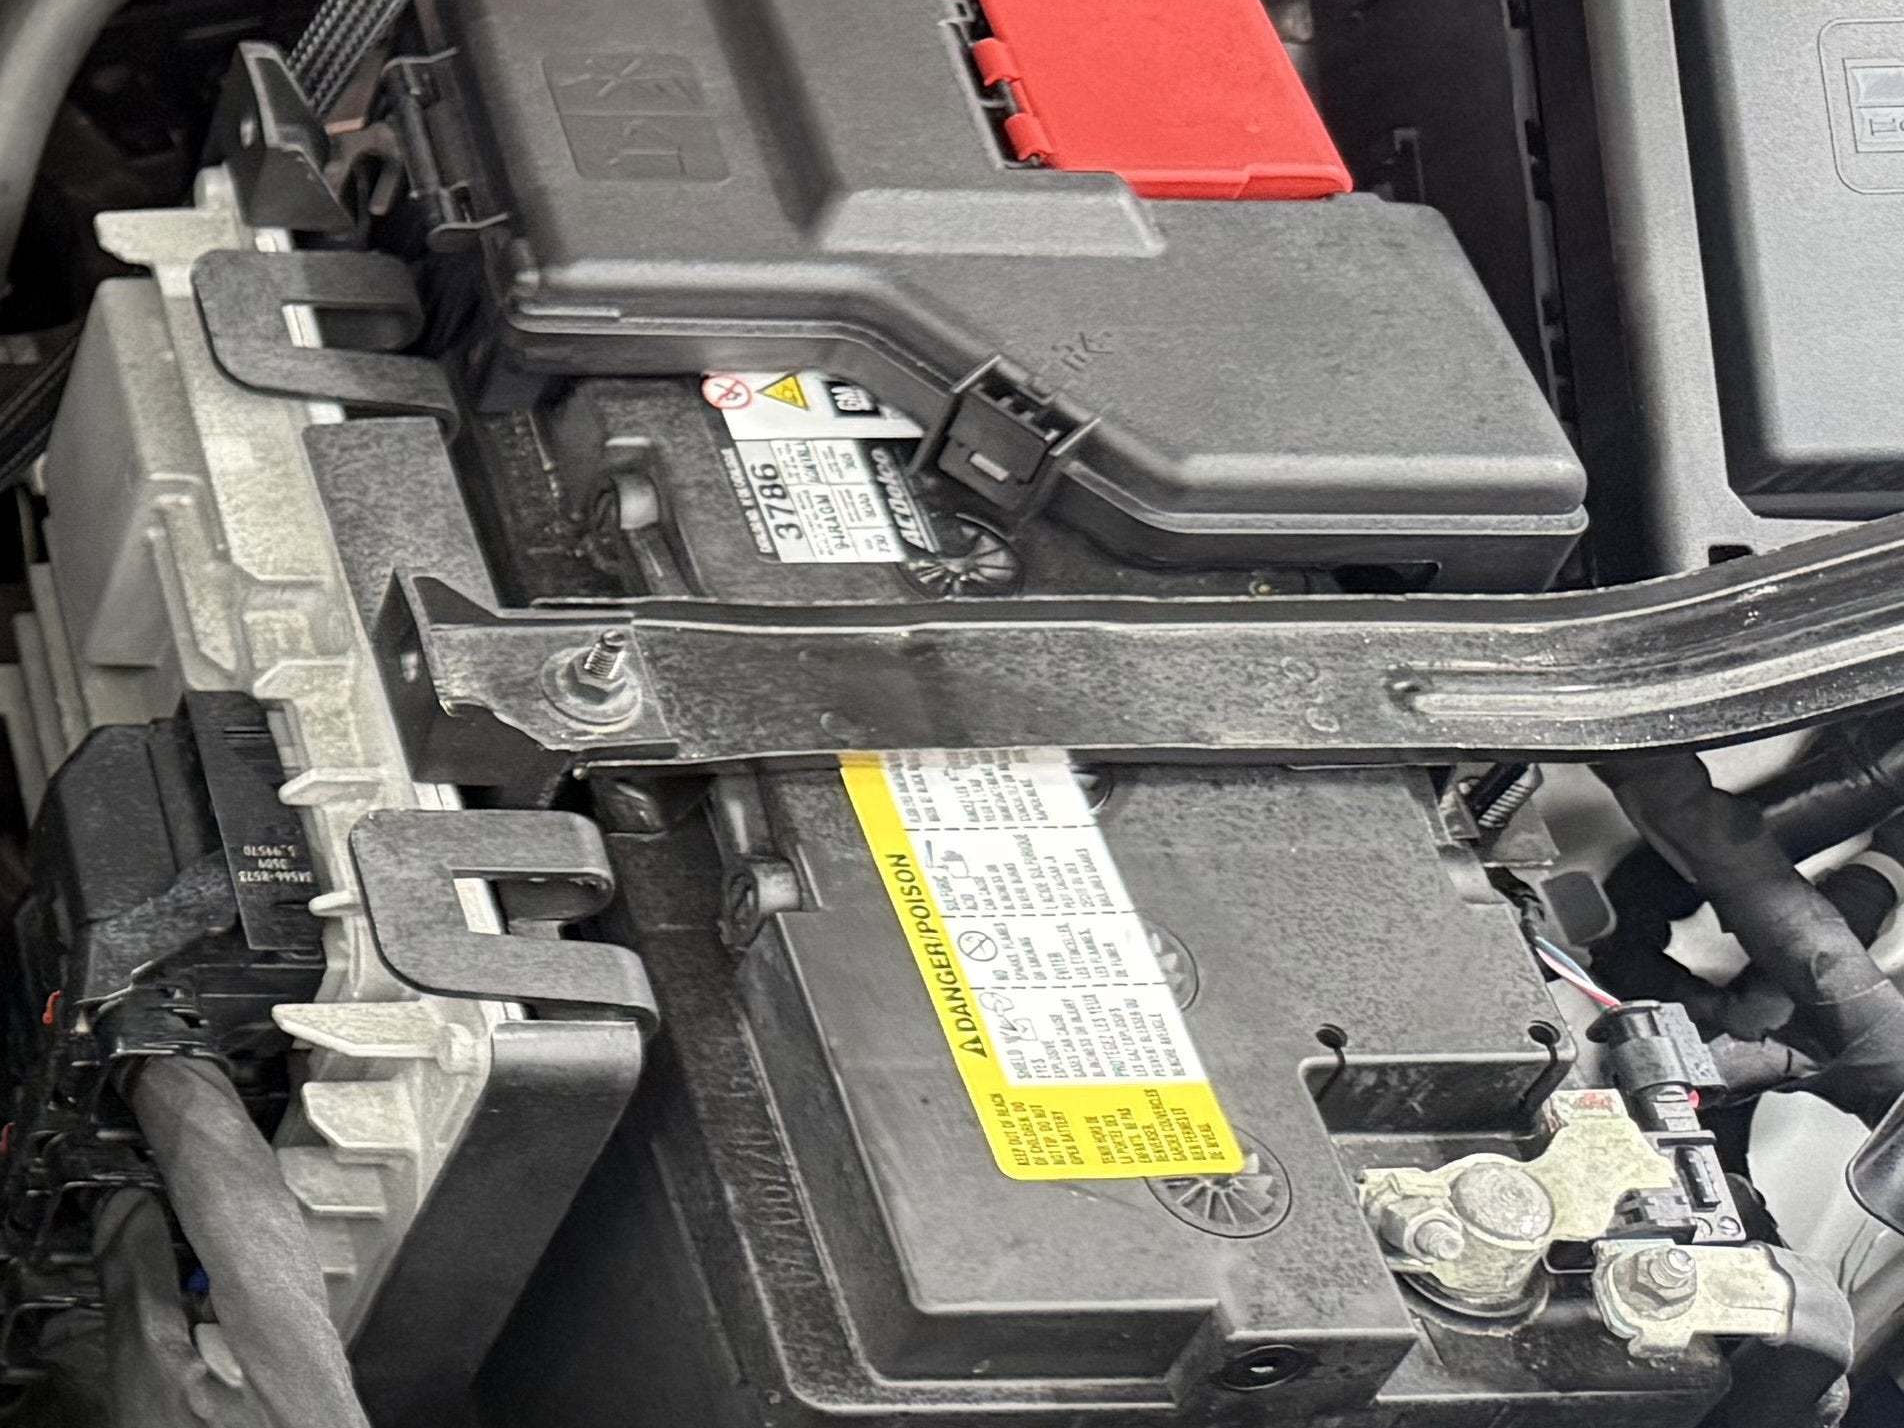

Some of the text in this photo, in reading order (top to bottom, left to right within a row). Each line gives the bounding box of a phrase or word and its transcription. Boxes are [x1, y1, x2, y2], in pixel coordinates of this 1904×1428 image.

[749, 463, 803, 540] 3786
[870, 447, 925, 549] ACDelco
[884, 854, 978, 1032] DANGER/POISON
